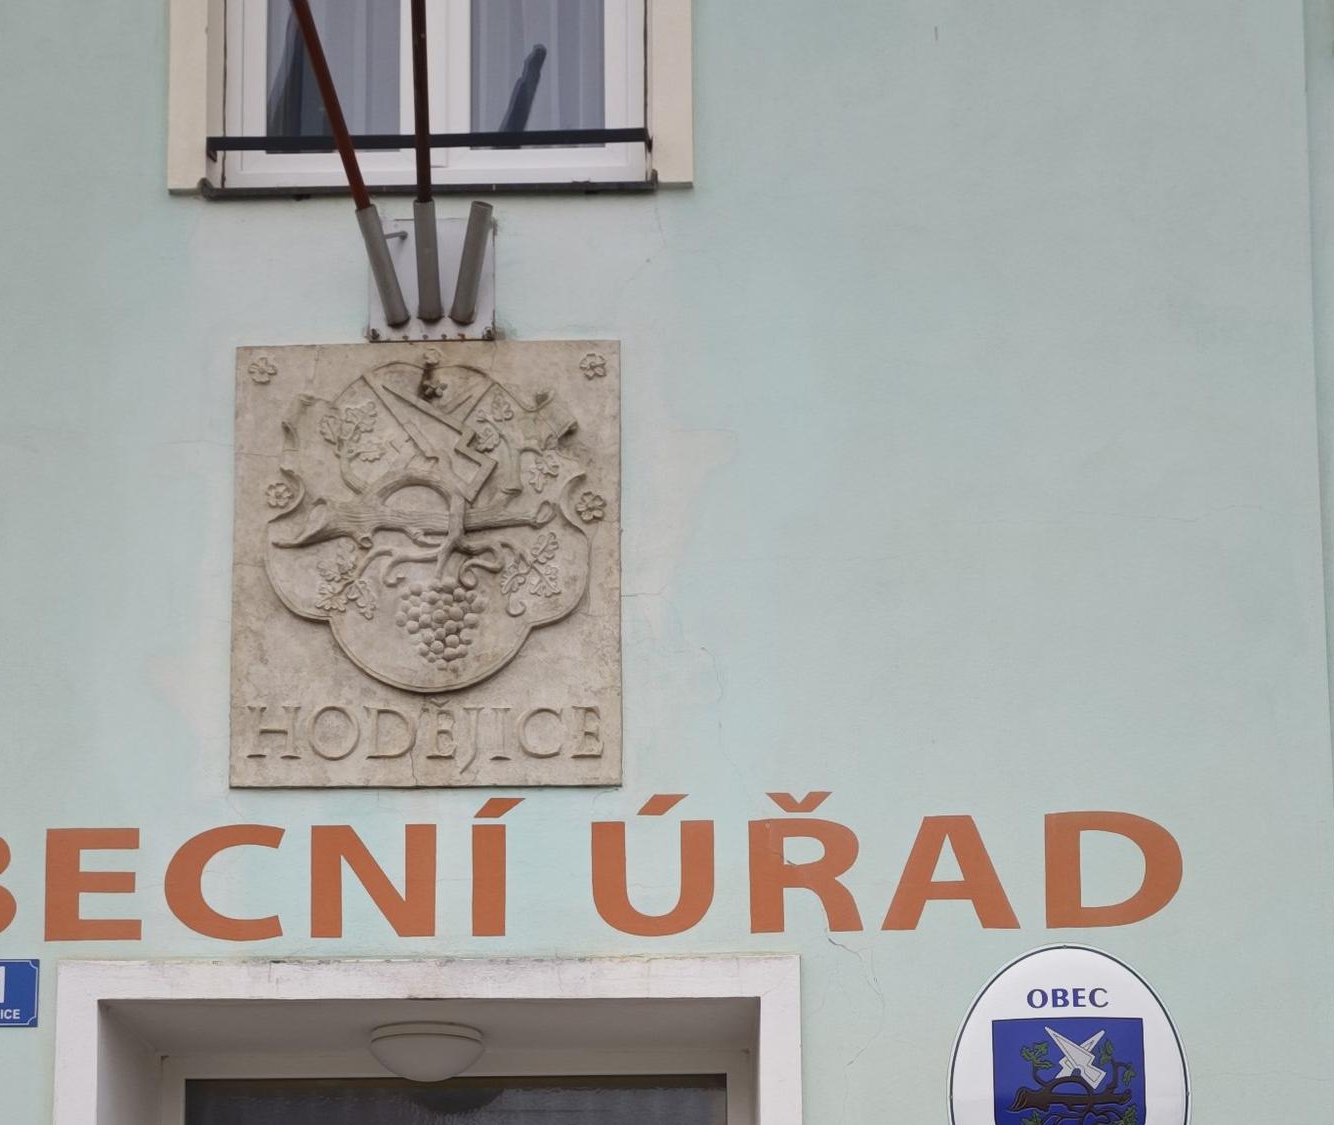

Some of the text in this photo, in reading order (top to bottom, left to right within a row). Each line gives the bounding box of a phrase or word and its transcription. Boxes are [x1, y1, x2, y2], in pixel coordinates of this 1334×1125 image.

[245, 699, 607, 775] HODĚJICE
[590, 791, 1184, 938] ÚŘAD
[1026, 987, 1109, 1009] OBEC
